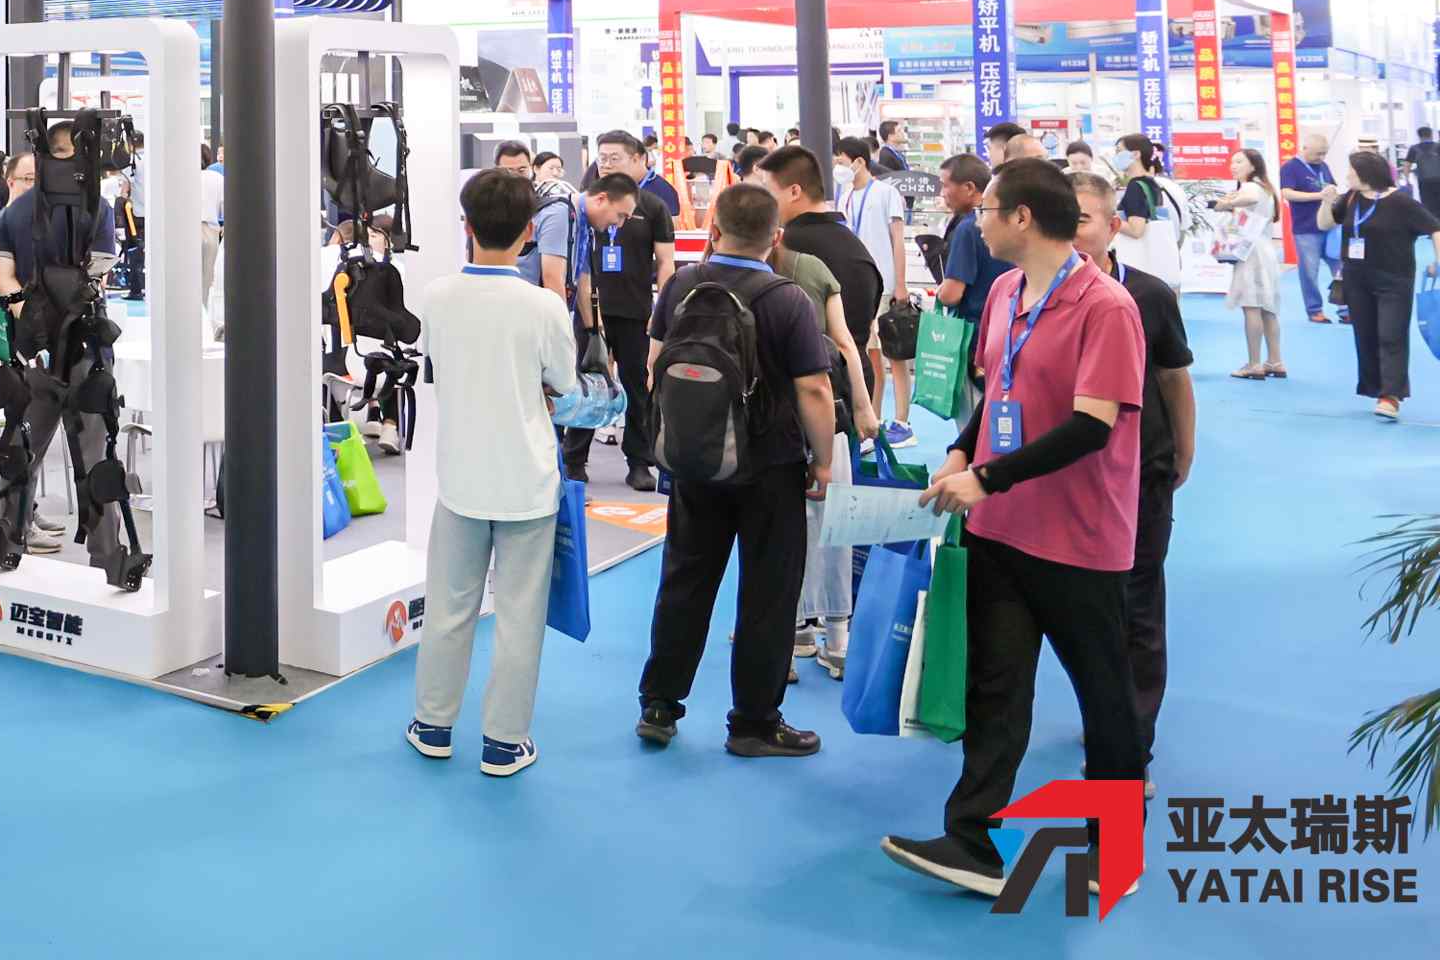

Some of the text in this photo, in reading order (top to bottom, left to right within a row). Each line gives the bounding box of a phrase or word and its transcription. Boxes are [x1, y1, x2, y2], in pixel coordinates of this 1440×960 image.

[1141, 31, 1161, 72] 矫平机
[980, 62, 1003, 117] 压花机
[1143, 78, 1162, 119] 压花机
[899, 184, 935, 193] CHZN
[9, 602, 83, 636] 迈宝智能
[16, 626, 73, 646] MEBOTX
